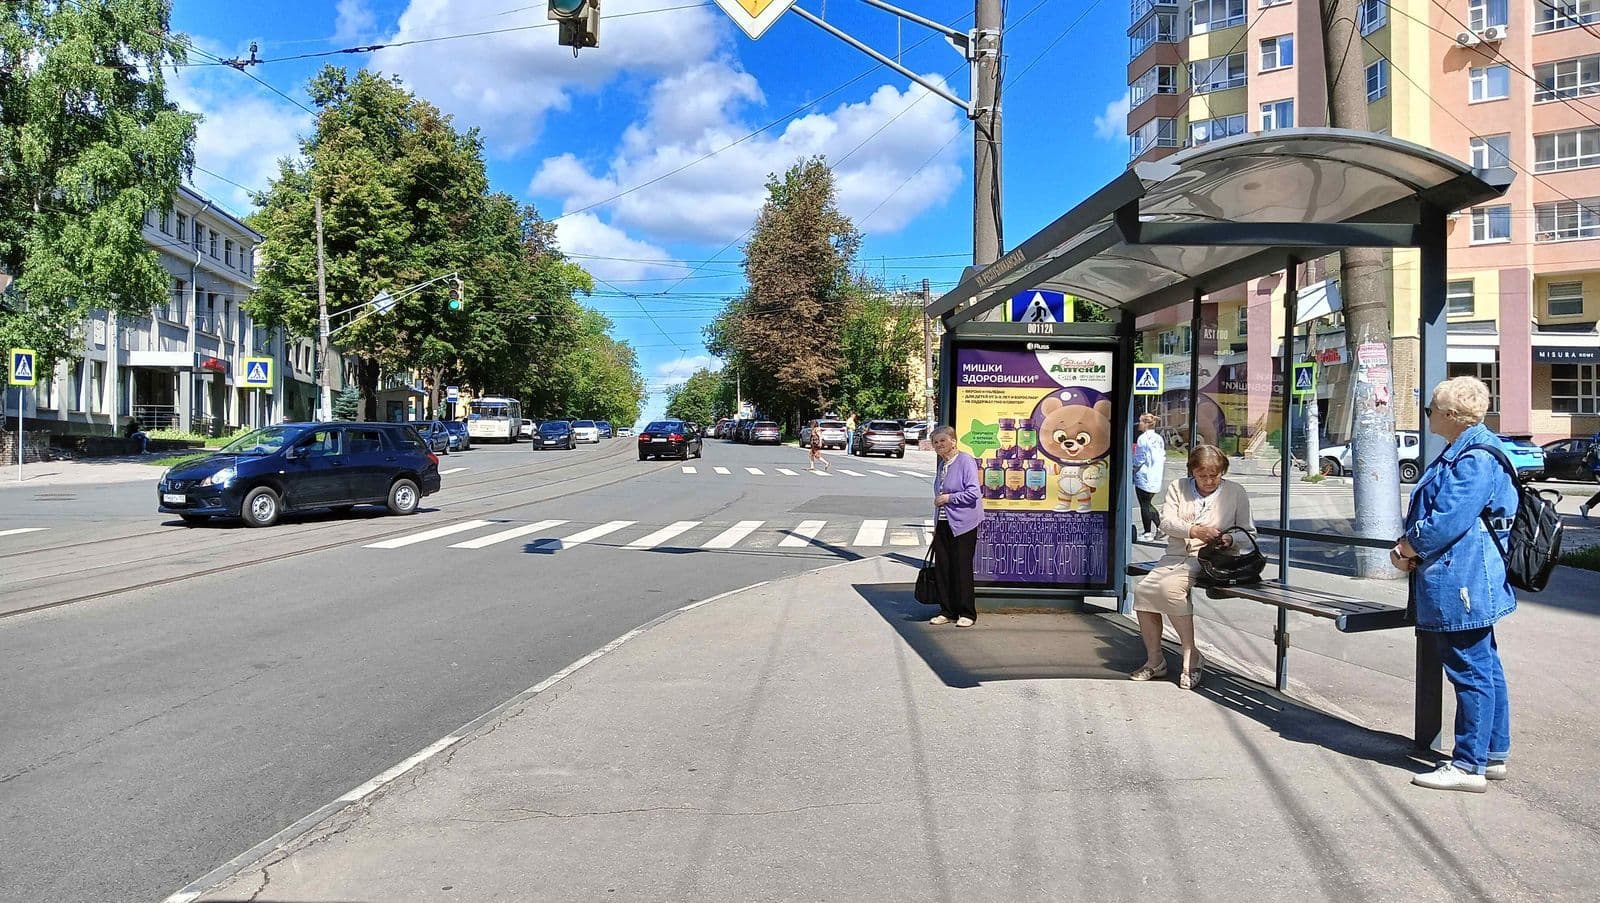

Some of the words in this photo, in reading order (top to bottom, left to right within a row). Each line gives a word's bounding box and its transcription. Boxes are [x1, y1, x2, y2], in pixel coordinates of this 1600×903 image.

[1027, 323, 1054, 334] 00112A
[1539, 351, 1577, 359] MISURA
[962, 363, 1003, 373] МИШКИ
